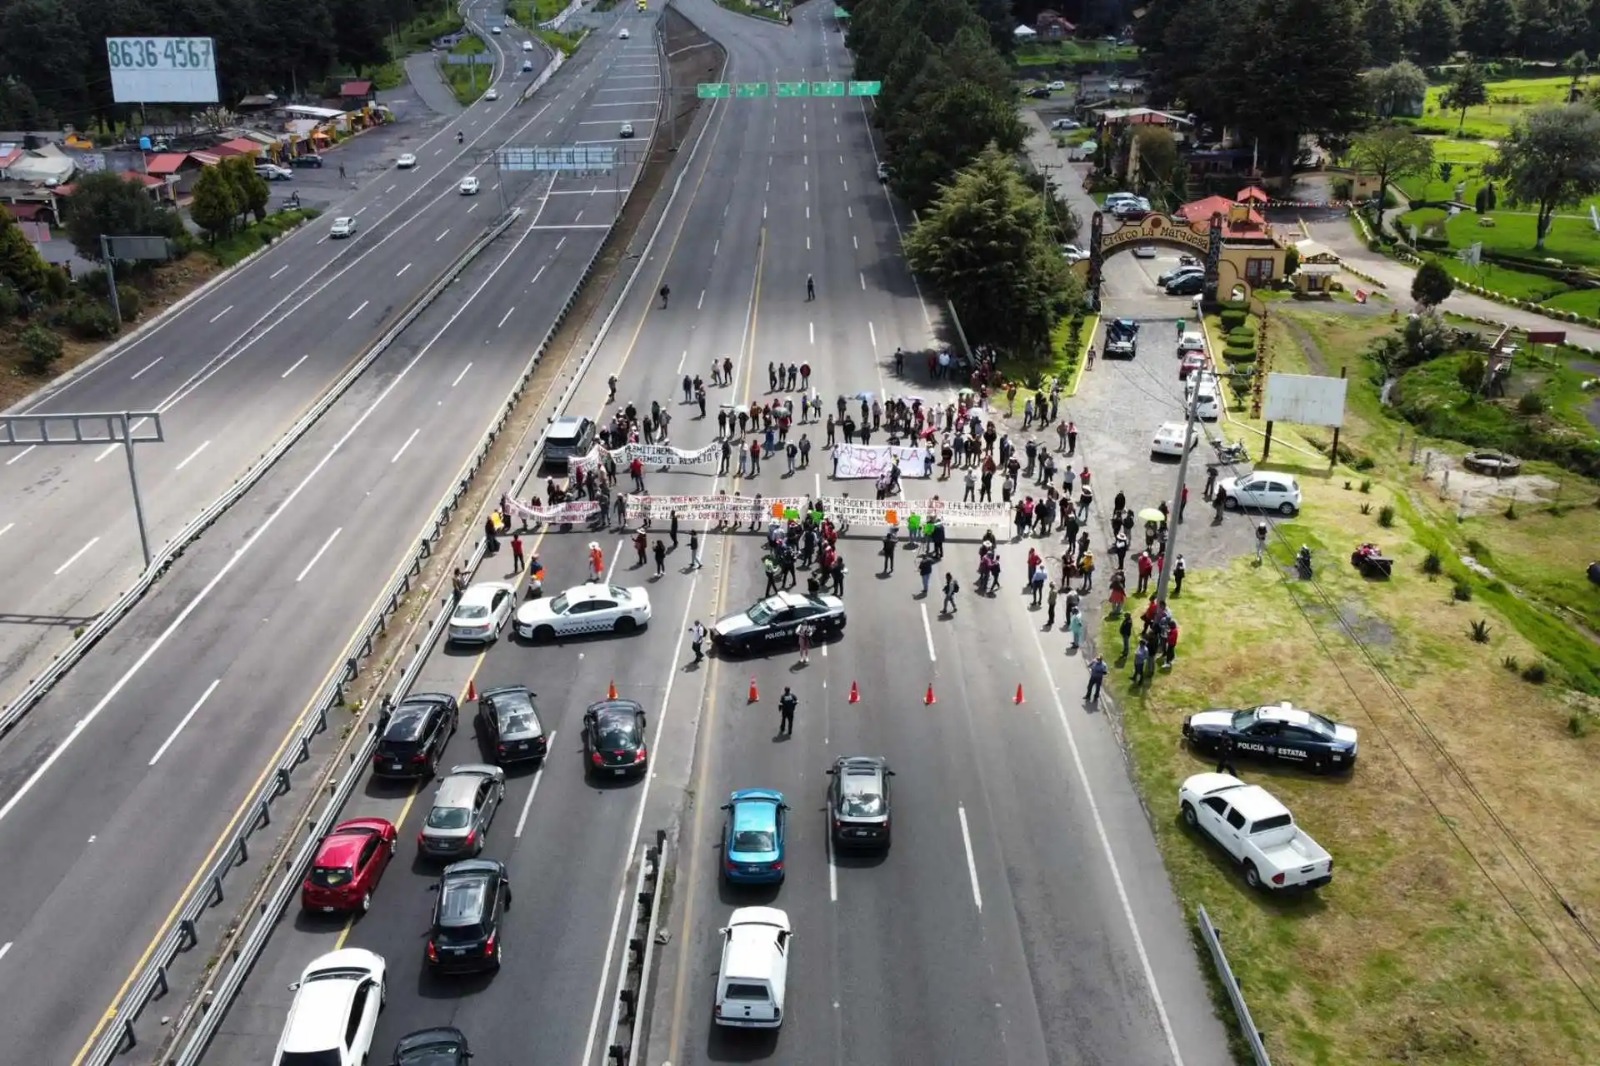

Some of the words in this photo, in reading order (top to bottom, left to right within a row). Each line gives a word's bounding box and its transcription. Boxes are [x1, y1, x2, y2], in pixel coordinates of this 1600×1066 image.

[1160, 227, 1209, 249] Marquesa
[666, 457, 676, 465] EL
[679, 454, 712, 465] RESPETO
[900, 449, 919, 461] LA
[834, 498, 873, 508] PRESIDENTE
[1237, 742, 1265, 752] POLICÍA
[1278, 747, 1308, 758] ESTATAL
